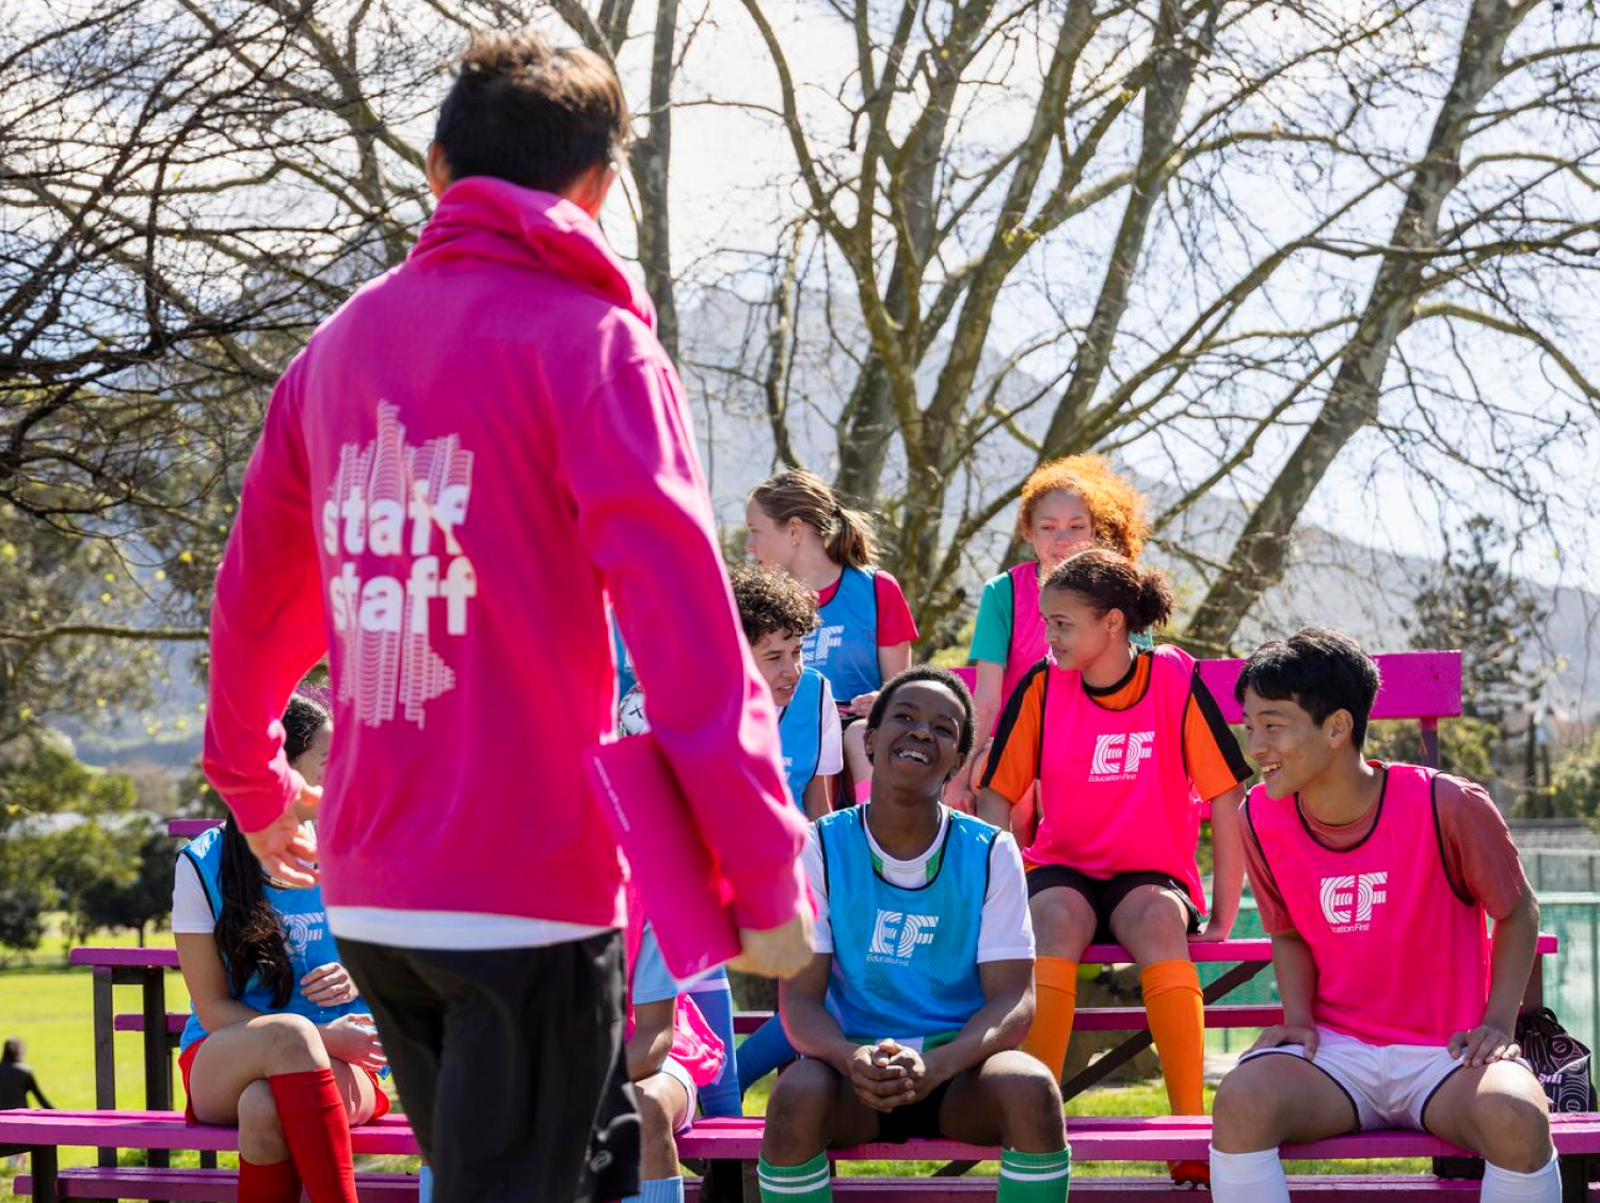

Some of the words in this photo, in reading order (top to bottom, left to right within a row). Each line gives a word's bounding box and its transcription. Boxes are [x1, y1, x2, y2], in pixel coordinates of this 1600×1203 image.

[322, 479, 471, 556] staff
[330, 555, 477, 636] staff
[1089, 730, 1155, 775] EF
[1319, 870, 1388, 924] EF
[868, 908, 940, 959] EF
